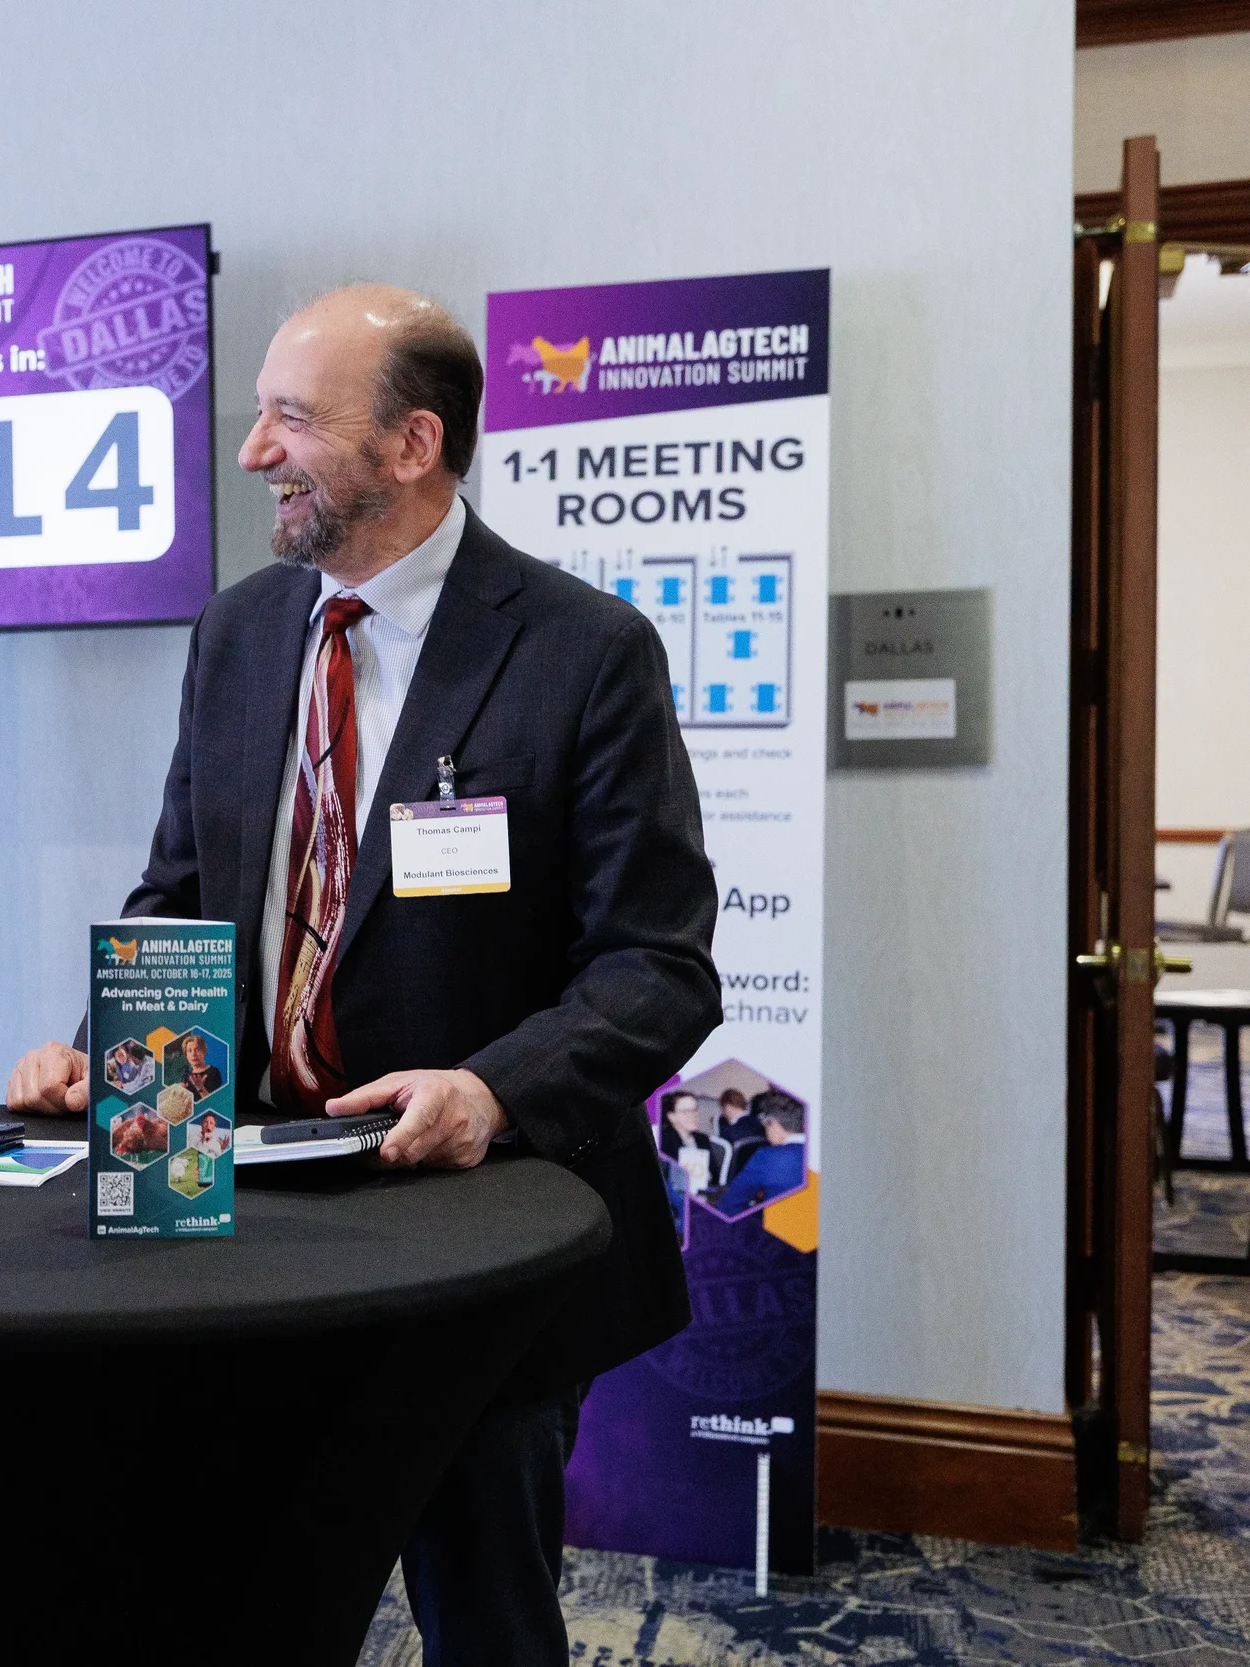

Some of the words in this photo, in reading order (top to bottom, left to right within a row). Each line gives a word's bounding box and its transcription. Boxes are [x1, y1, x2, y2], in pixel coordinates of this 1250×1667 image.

[62, 288, 207, 363] DALLAS
[599, 324, 809, 365] ANIMALAGTECH
[10, 345, 46, 372] in:
[599, 363, 720, 391] INNOVATION
[727, 357, 808, 385] SUMMIT
[504, 448, 558, 482] 1-1
[577, 437, 804, 480] MEETING
[557, 487, 747, 526] ROOMS
[865, 640, 934, 656] DALLAS
[454, 825, 481, 834] Campi
[404, 870, 443, 879] Modulant
[445, 867, 498, 877] Biosciences
[723, 887, 790, 919] App
[141, 939, 232, 954] ANIMALAGTECH
[141, 954, 196, 965] INNOVATION
[199, 954, 232, 965] SUMMIT
[96, 969, 148, 980] AMSTERDAM,
[151, 968, 188, 979] OCTOBER
[190, 968, 210, 979] 16-17,
[213, 968, 232, 979] 2025
[101, 987, 161, 1000] Advancing
[165, 987, 188, 998] One
[191, 986, 228, 998] Health
[122, 1001, 133, 1011] in
[136, 1001, 165, 1011] Meat
[167, 1001, 176, 1011] &
[179, 1001, 208, 1013] Dairy
[108, 1225, 159, 1235] AnimalAgTech
